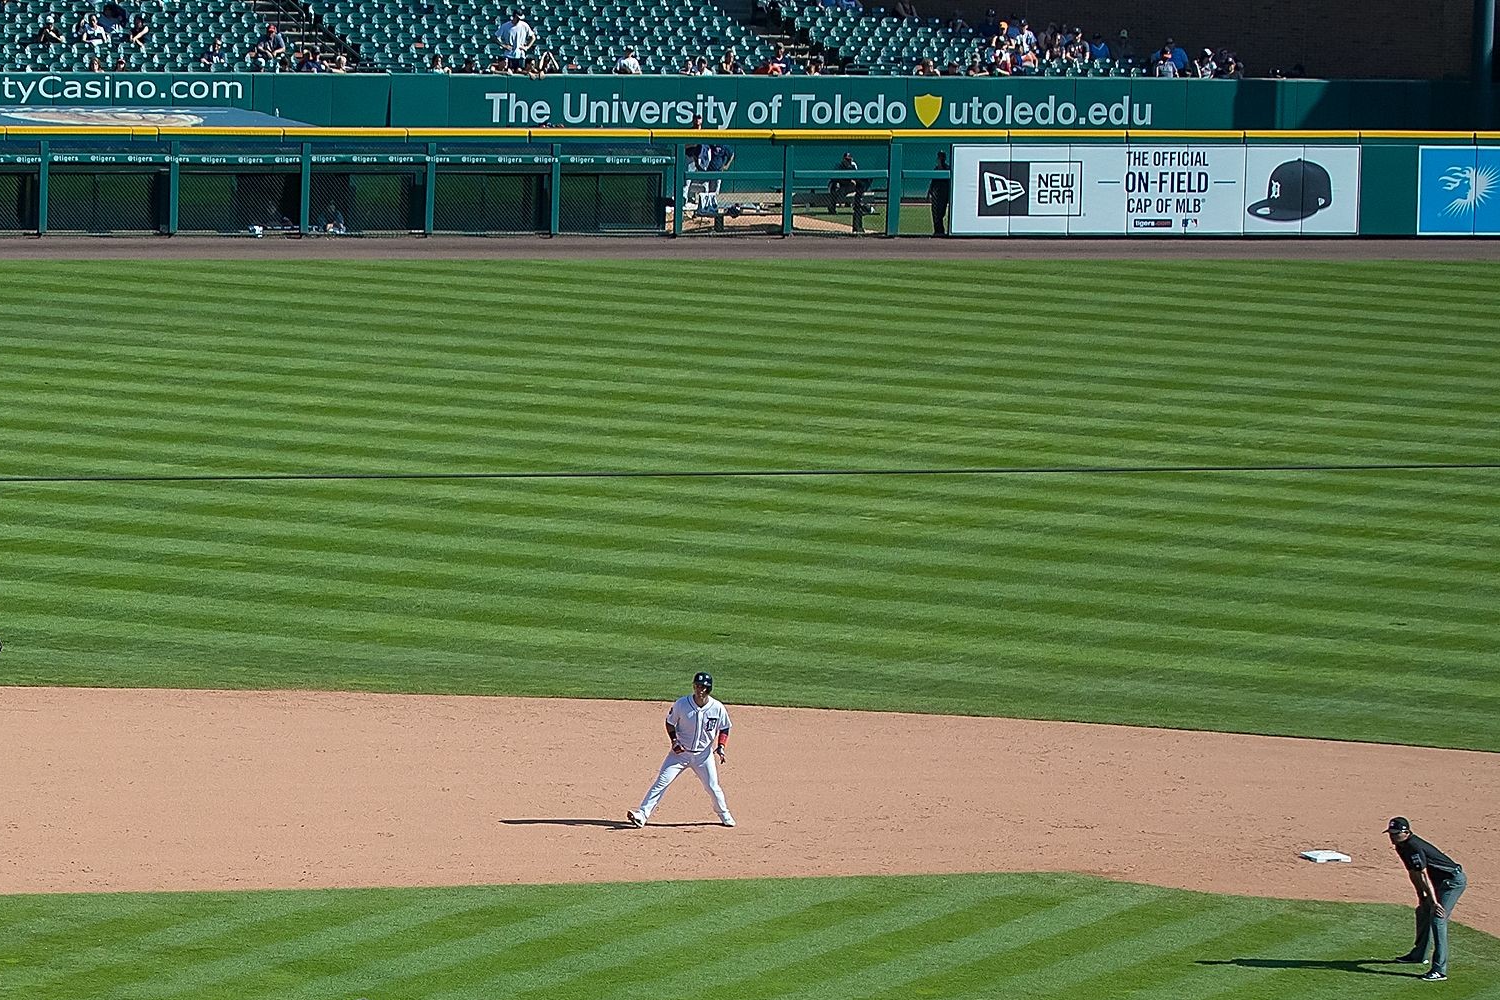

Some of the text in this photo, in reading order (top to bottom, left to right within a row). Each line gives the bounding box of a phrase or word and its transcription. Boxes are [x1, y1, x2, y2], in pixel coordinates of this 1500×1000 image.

[485, 92, 1153, 130] The University of Toledo utoledo.edu
[16, 156, 42, 165] @tigers
[53, 154, 79, 163] @tigers
[90, 154, 116, 163] @tigers
[127, 155, 153, 164] @tigers
[164, 155, 190, 164] @tigers
[201, 156, 227, 165] @tigers
[238, 156, 264, 165] @tigers
[274, 156, 300, 165] @tigers
[311, 155, 337, 164] @tigers
[352, 155, 378, 164] @tigers
[388, 156, 414, 165] @tigers
[423, 155, 449, 164] @tigers
[461, 156, 487, 165] @tigers
[497, 156, 523, 165] @tigers
[533, 156, 559, 165] @tigers
[569, 156, 595, 165] @tigers
[604, 156, 630, 165] @tigers
[641, 156, 667, 165] @tigers
[1126, 151, 1209, 167] THE OFFICIAL
[1037, 173, 1075, 189] NEW
[1125, 171, 1209, 194] ON-FIELD
[1037, 189, 1074, 204] ERA
[1127, 199, 1151, 214] CAP
[1156, 199, 1171, 214] OF
